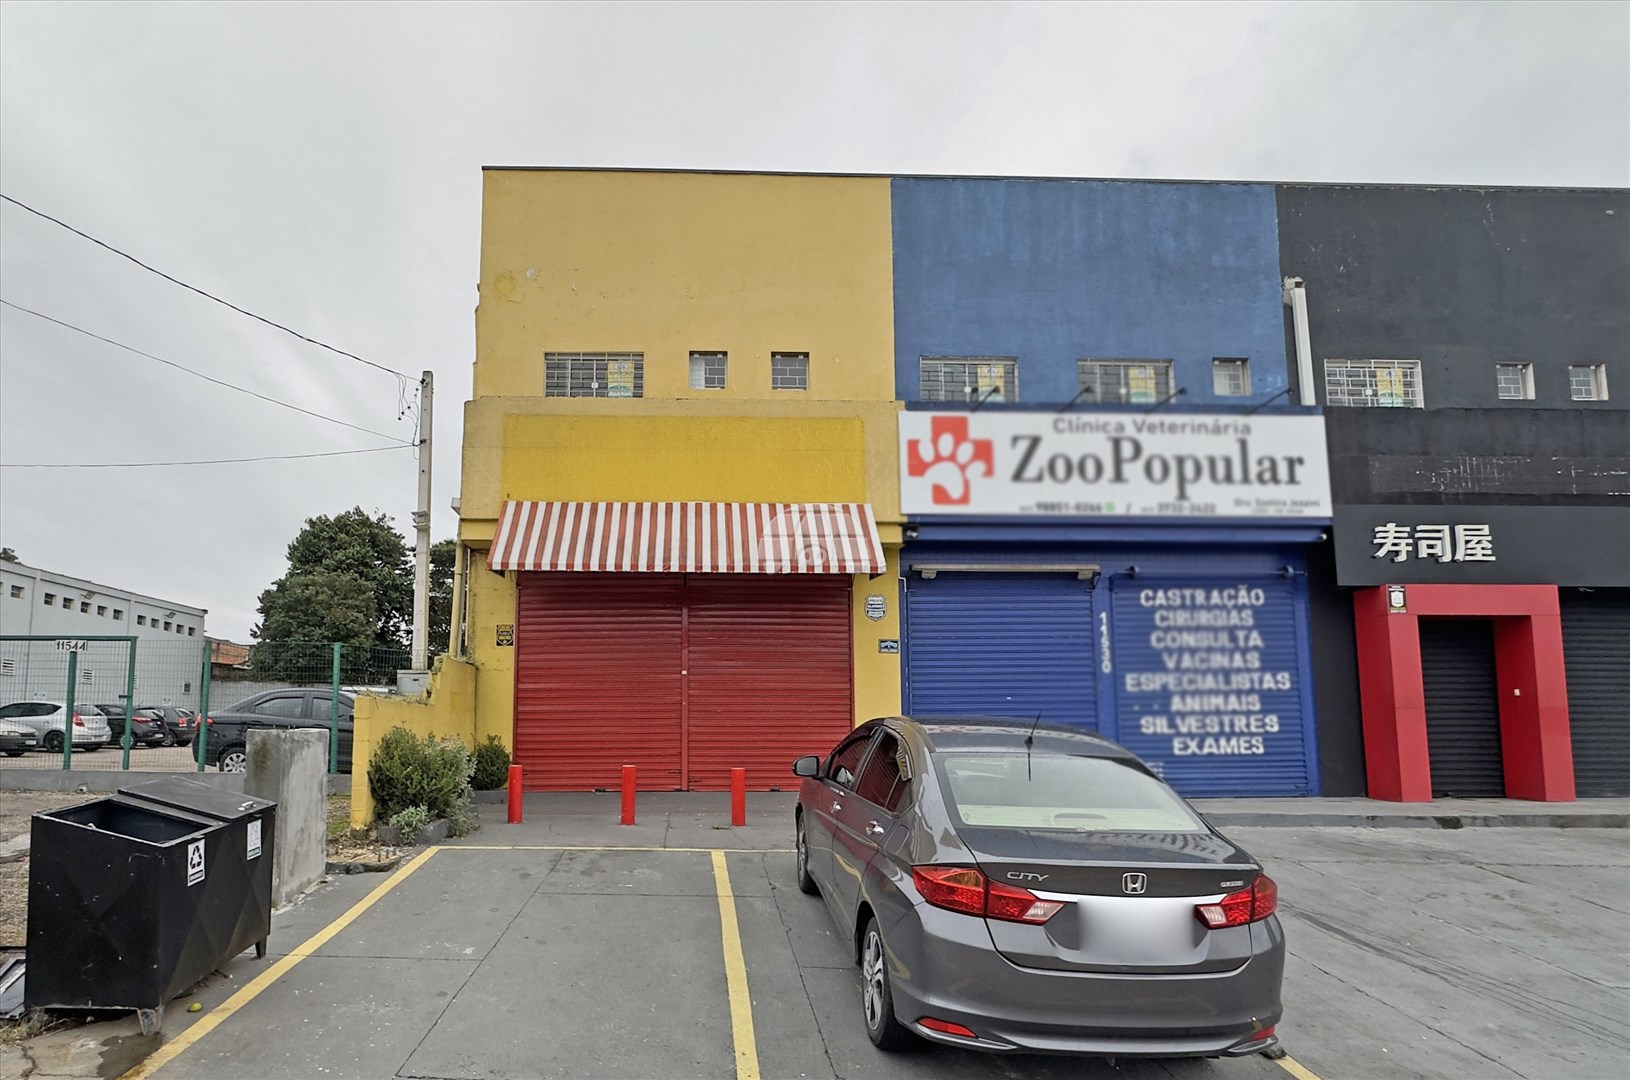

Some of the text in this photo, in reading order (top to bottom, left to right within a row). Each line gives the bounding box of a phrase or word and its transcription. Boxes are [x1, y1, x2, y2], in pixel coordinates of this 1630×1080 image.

[1052, 417, 1252, 436] Clínica Veterinária
[1009, 434, 1305, 501] ZooPopular
[1372, 522, 1497, 563] 寿司屋
[1139, 584, 1266, 608] CASTRAÇÃO
[1154, 609, 1254, 627] CIRURGIAS
[1150, 630, 1265, 649] CONSULTA
[1162, 651, 1262, 670] VACINAS
[1125, 672, 1292, 692] ESPECIALISTAS
[1169, 694, 1262, 712] ANIMAIS
[1139, 714, 1280, 734] SILVESTRES
[1172, 736, 1266, 756] EXAMES
[1006, 871, 1050, 882] CITY
